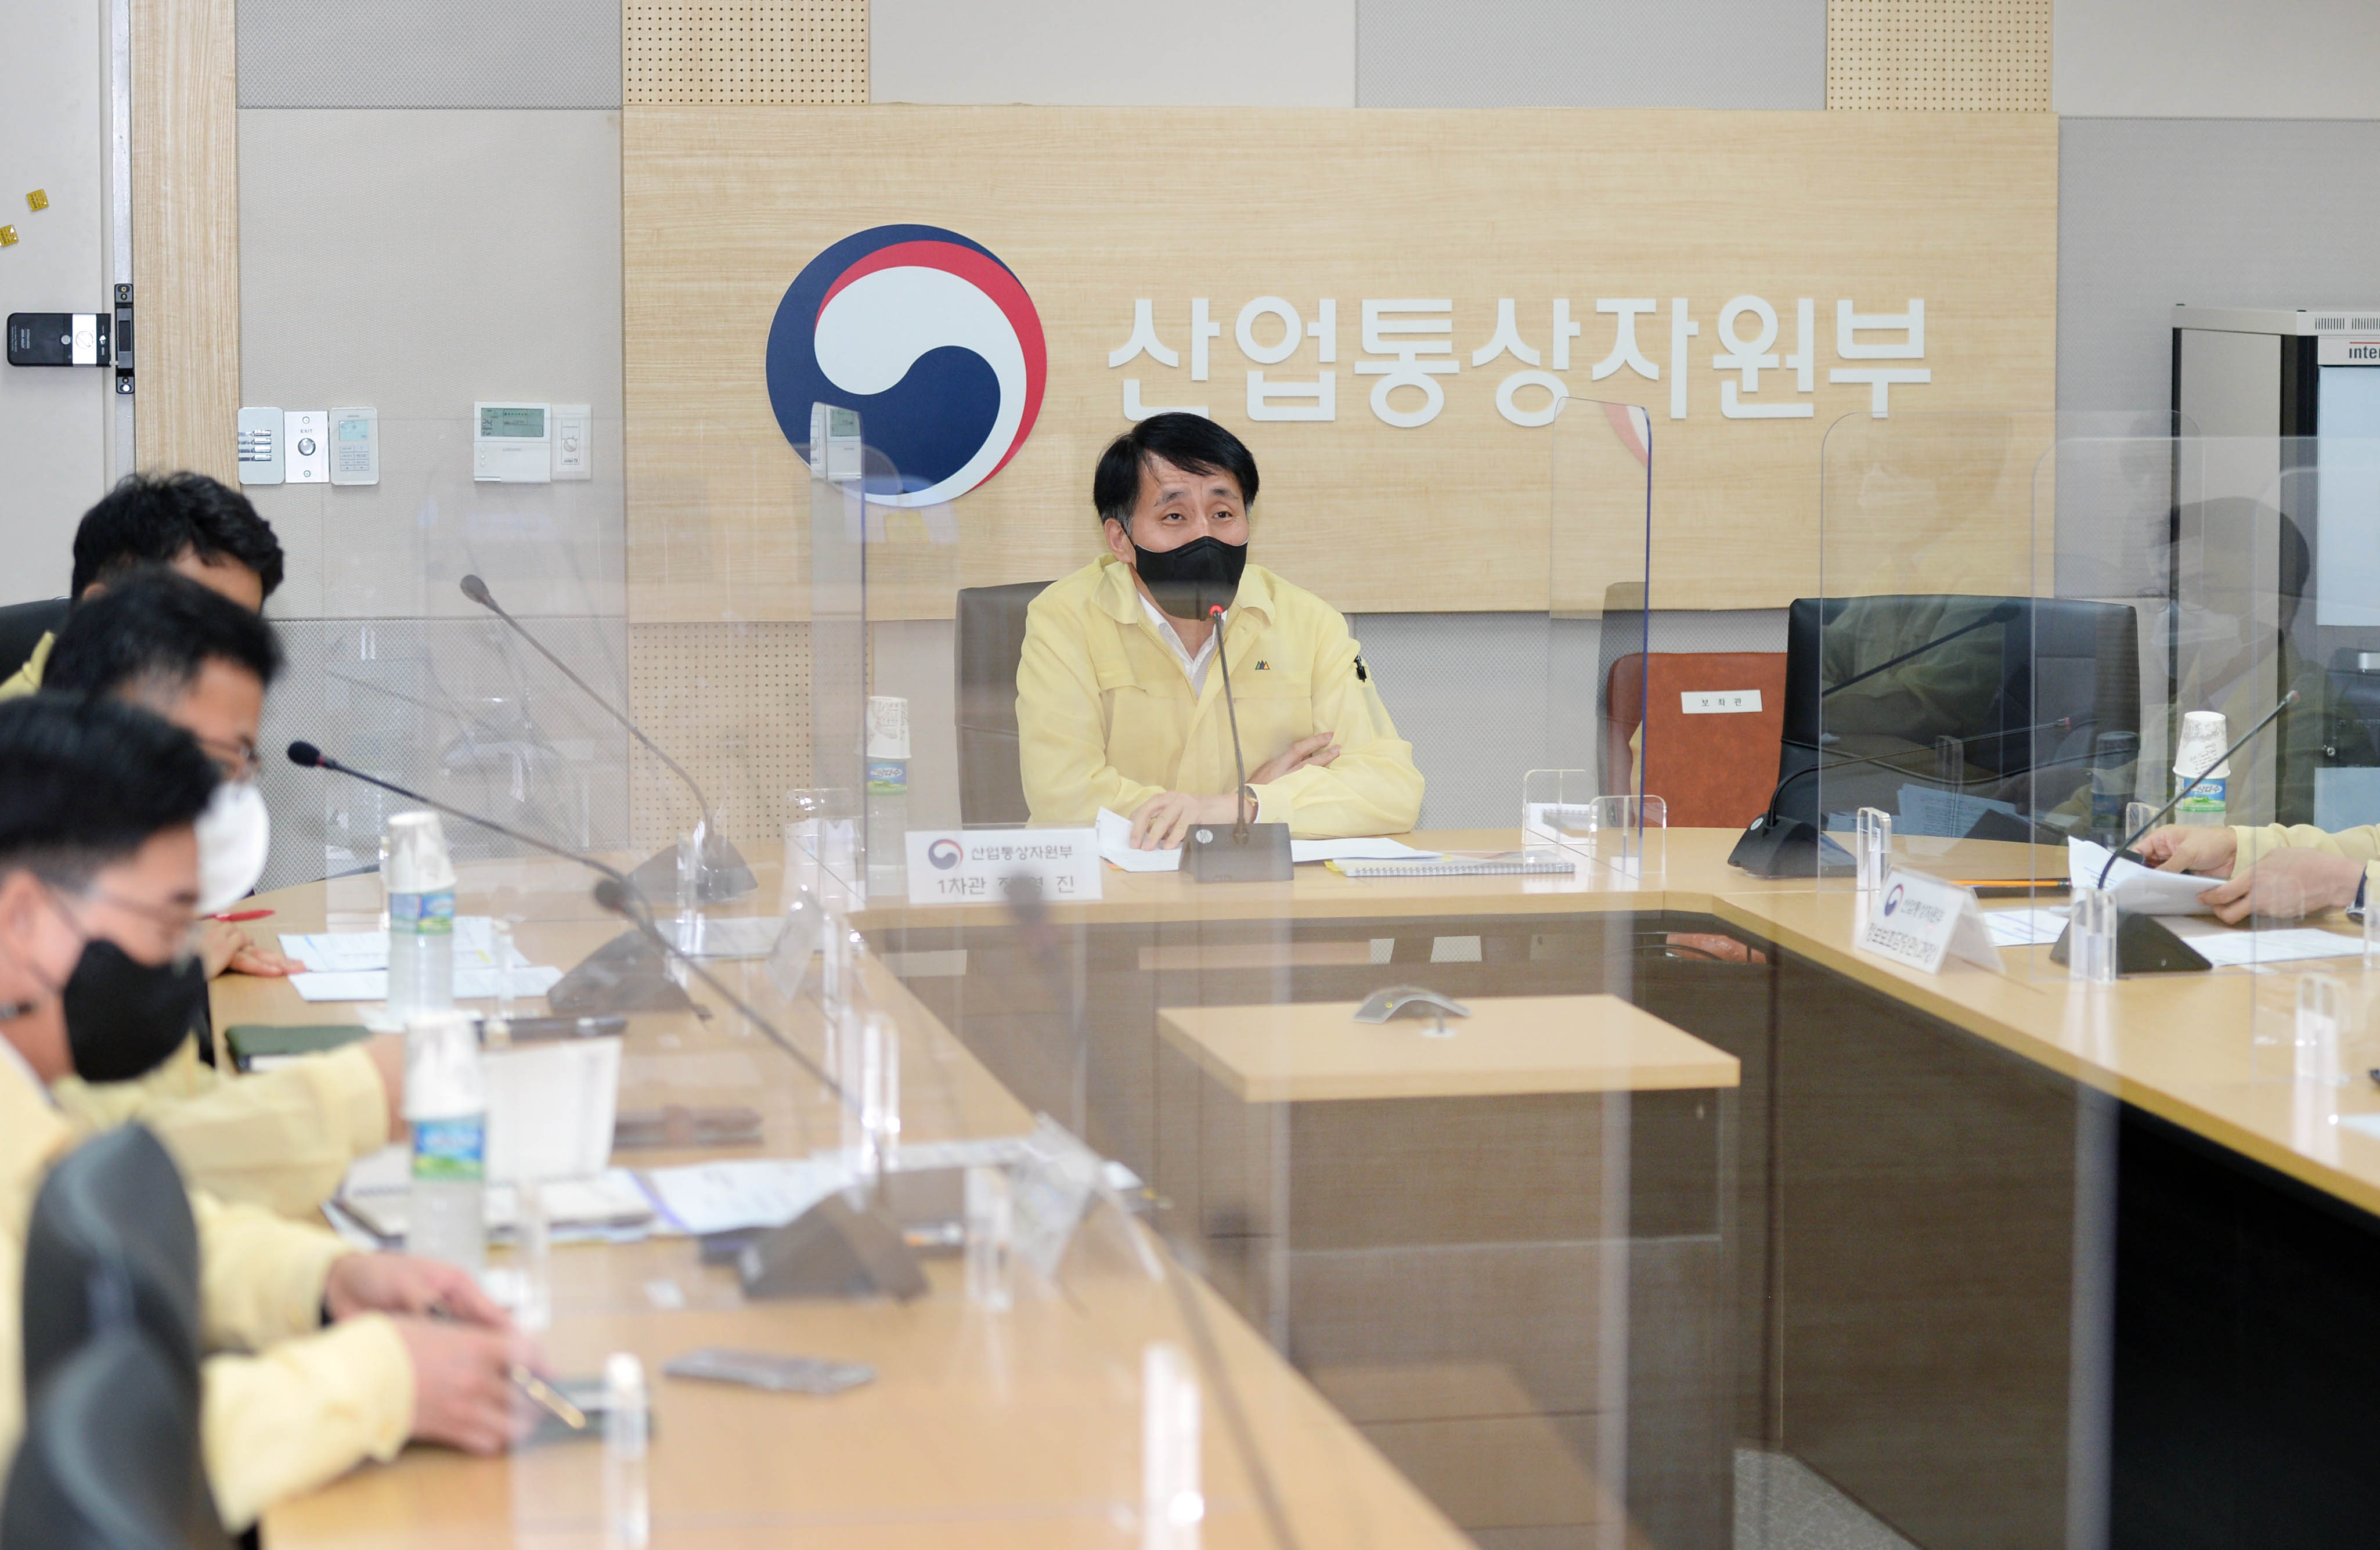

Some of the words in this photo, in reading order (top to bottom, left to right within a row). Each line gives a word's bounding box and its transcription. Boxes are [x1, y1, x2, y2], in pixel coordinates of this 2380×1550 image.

[1108, 294, 1931, 428] 산업통상자원부
[2349, 346, 2380, 359] inte
[971, 845, 1073, 861] 산업통상자원부
[937, 877, 986, 895] 1차관
